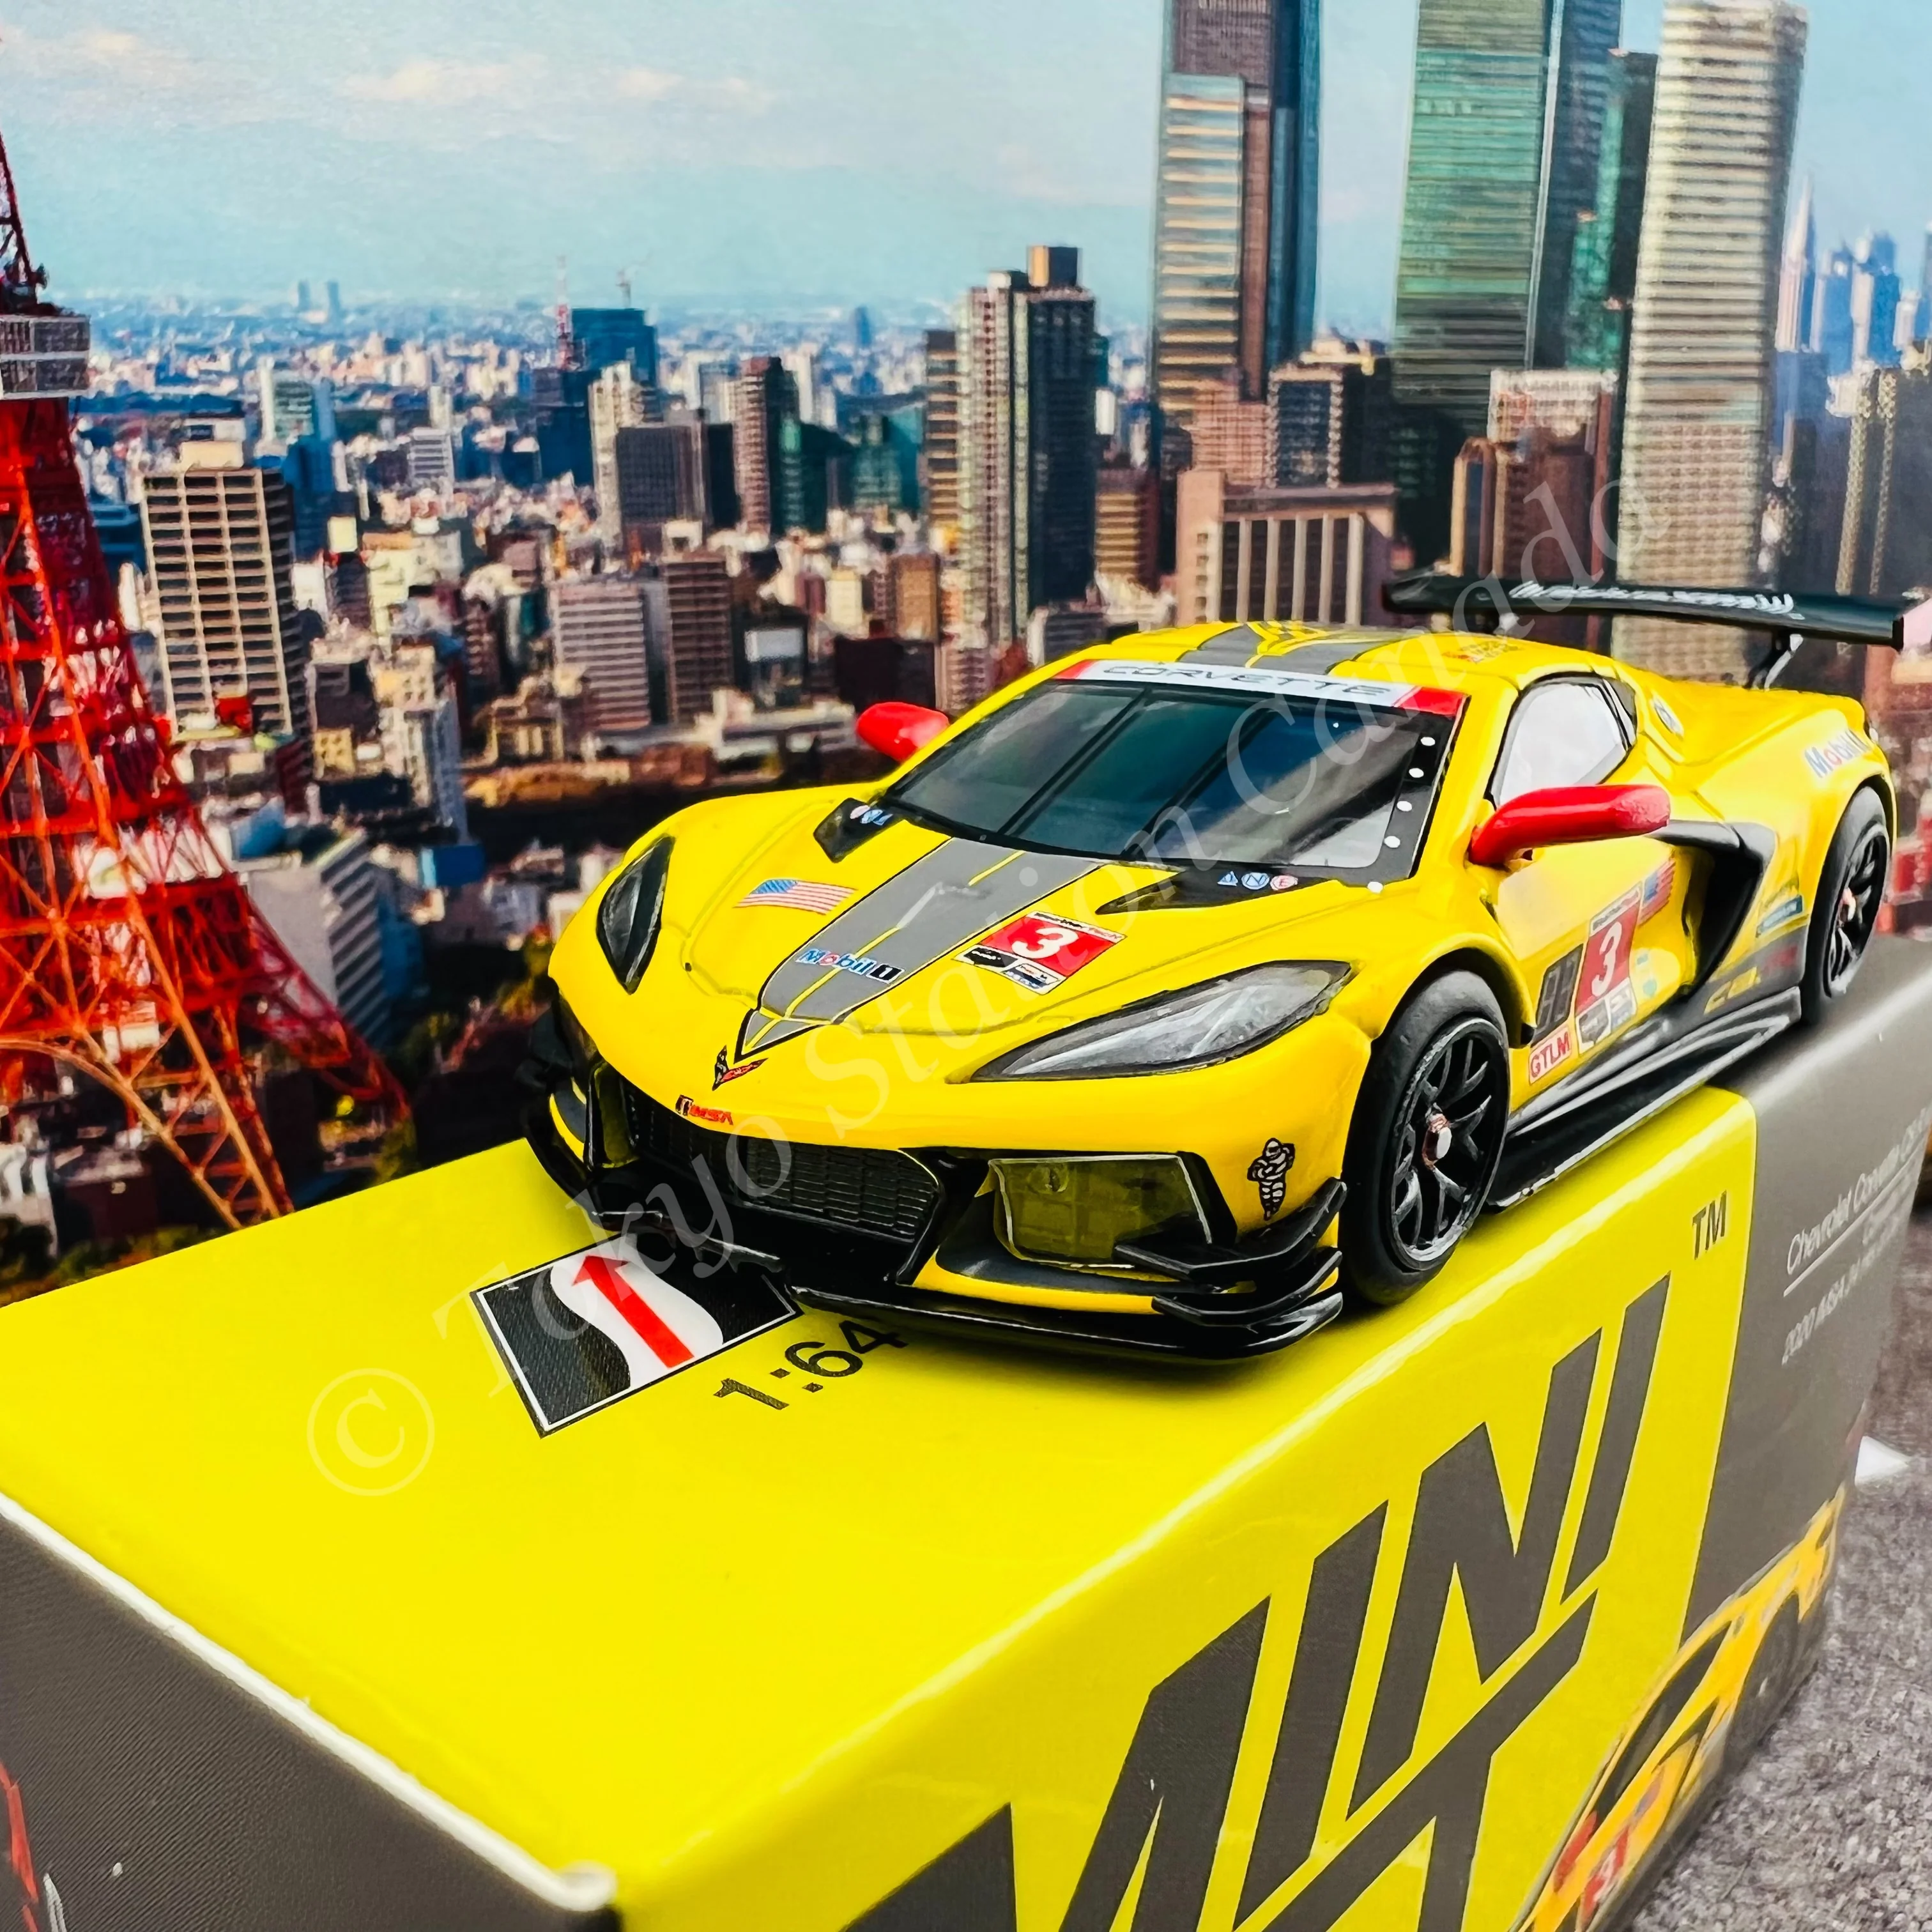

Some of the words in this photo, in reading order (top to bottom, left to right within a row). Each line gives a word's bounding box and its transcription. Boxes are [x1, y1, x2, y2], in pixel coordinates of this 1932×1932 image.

[795, 948, 877, 976] Mobil
[1012, 927, 1079, 959] 3
[1591, 921, 1623, 997] 3
[1530, 1031, 1570, 1078] GTLM
[1692, 1190, 1727, 1260] TM
[713, 1320, 908, 1410] 1:64
